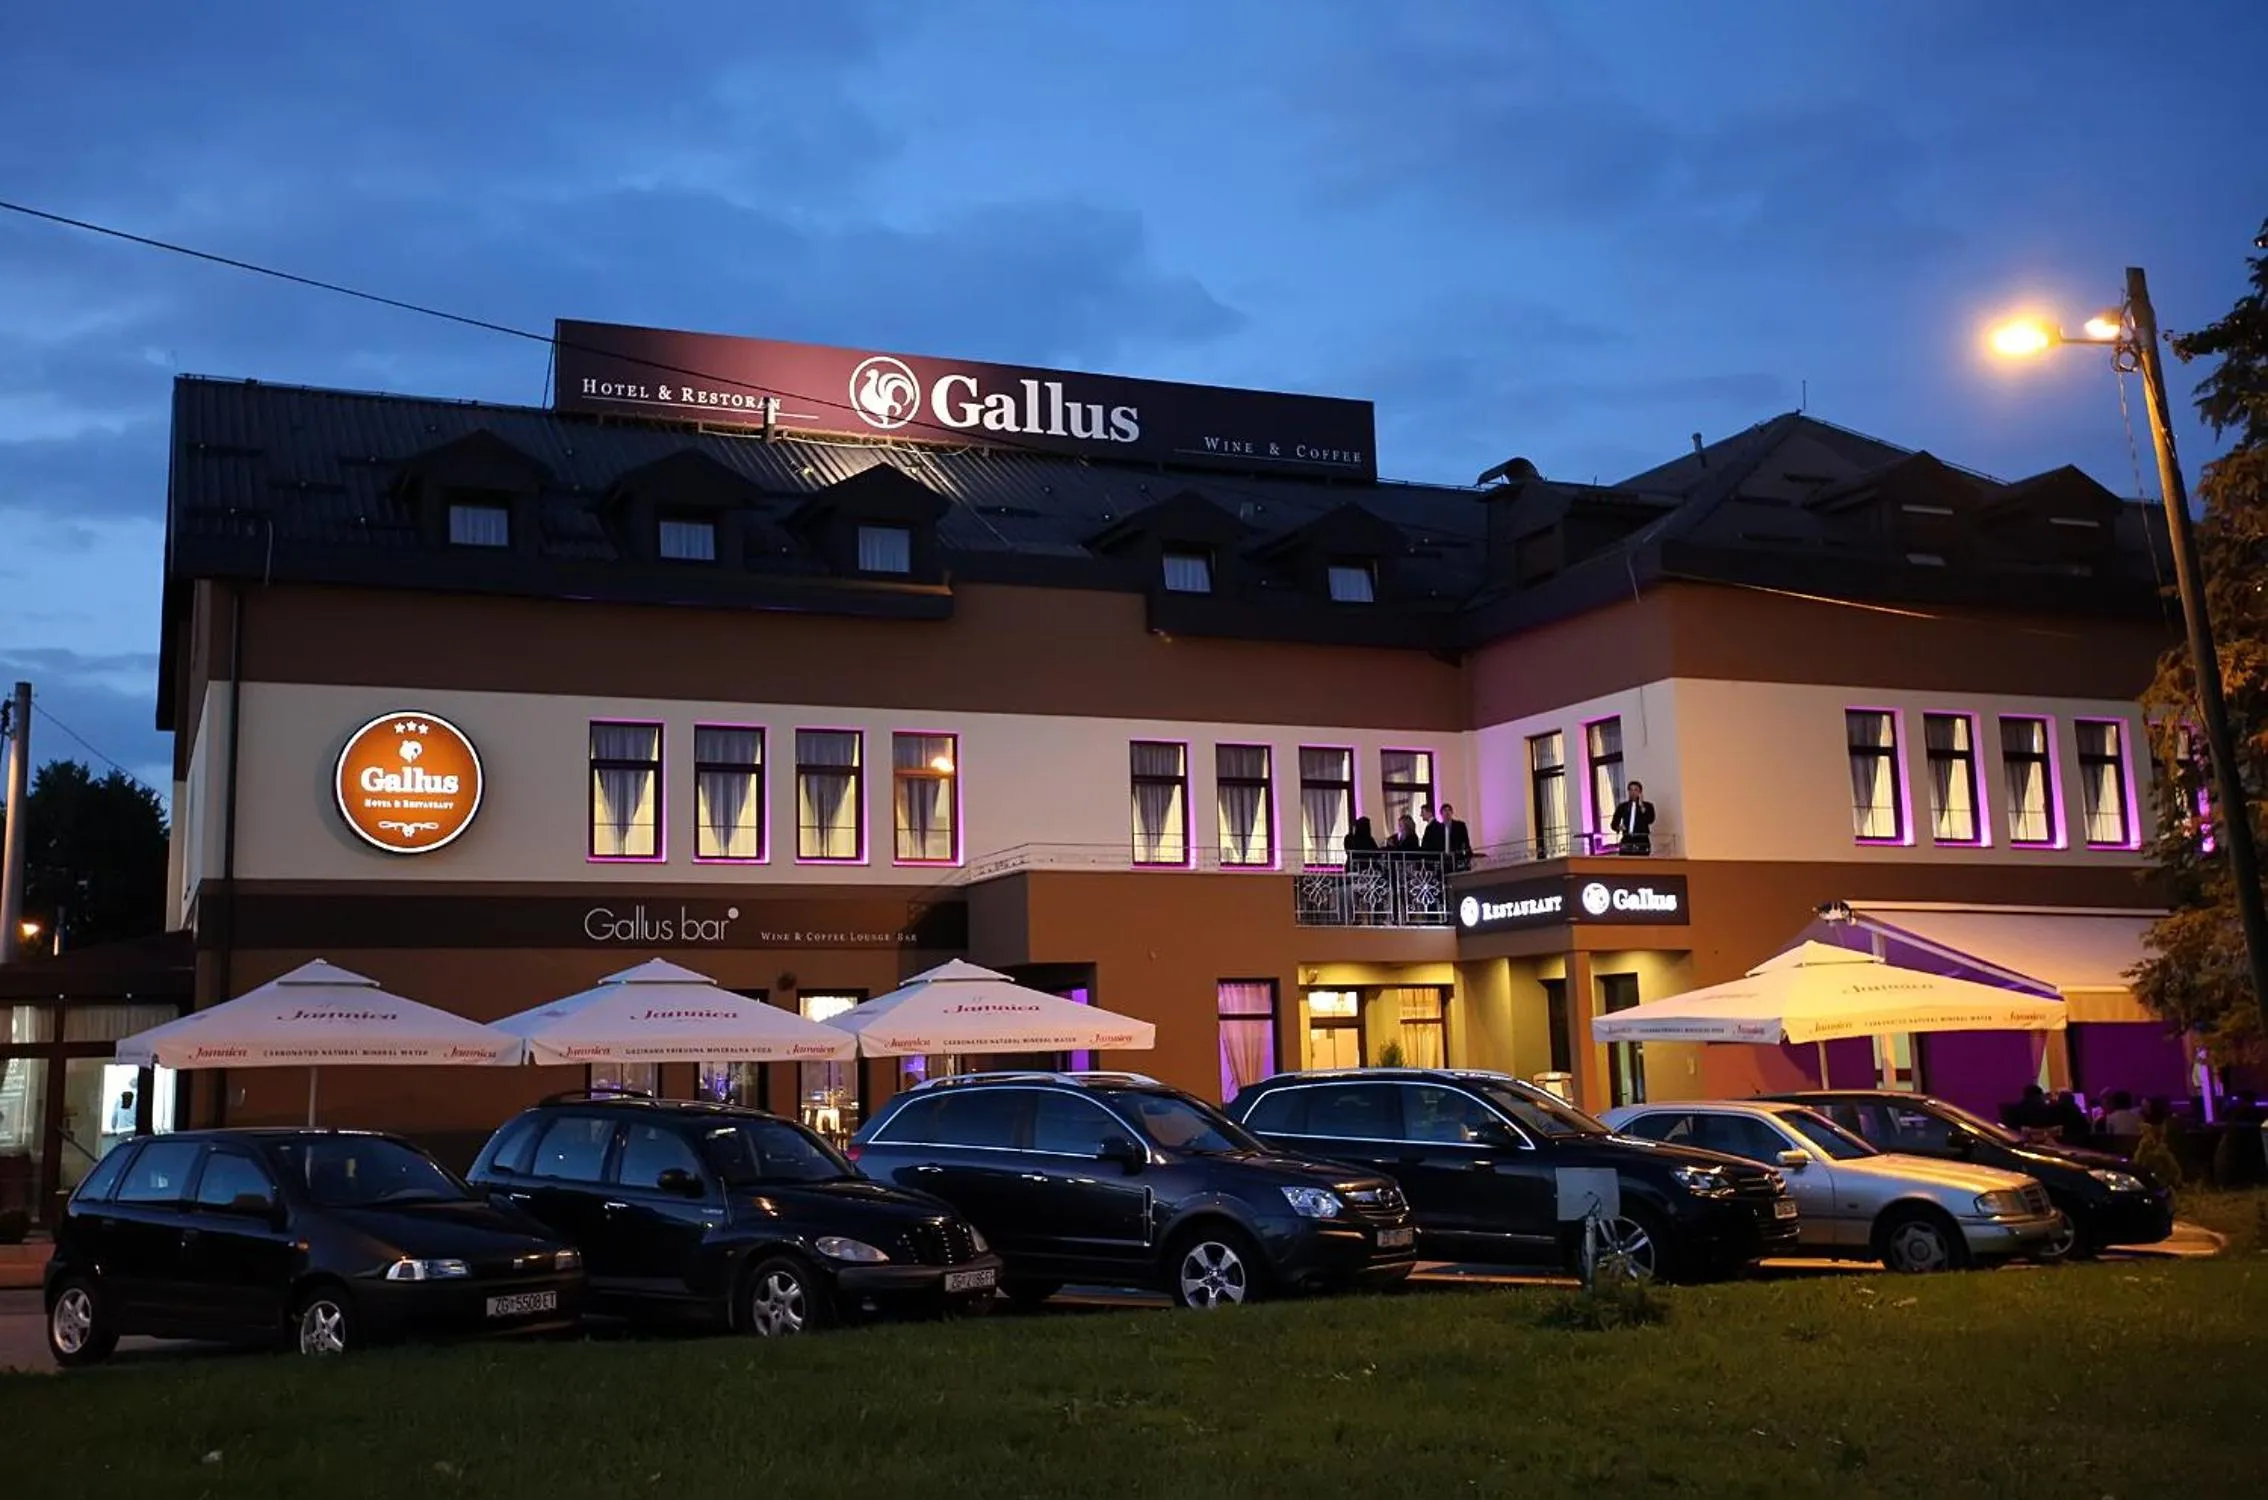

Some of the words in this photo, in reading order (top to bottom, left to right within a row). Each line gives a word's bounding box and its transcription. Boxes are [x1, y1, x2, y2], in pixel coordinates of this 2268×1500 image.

[583, 378, 649, 398] HOTEL
[658, 384, 672, 400] &
[931, 374, 1140, 443] Gallus
[1204, 436, 1254, 455] WINE
[1269, 442, 1280, 456] &
[1296, 444, 1363, 463] COFFEE
[361, 766, 459, 794] Gallus
[1482, 896, 1562, 921] RESTAURANT
[1612, 888, 1677, 911] Gallus
[584, 905, 673, 941] Gallus
[681, 906, 729, 941] bar
[760, 931, 790, 942] WINE
[806, 931, 846, 942] COFFEE
[850, 931, 890, 942] LOUNGE
